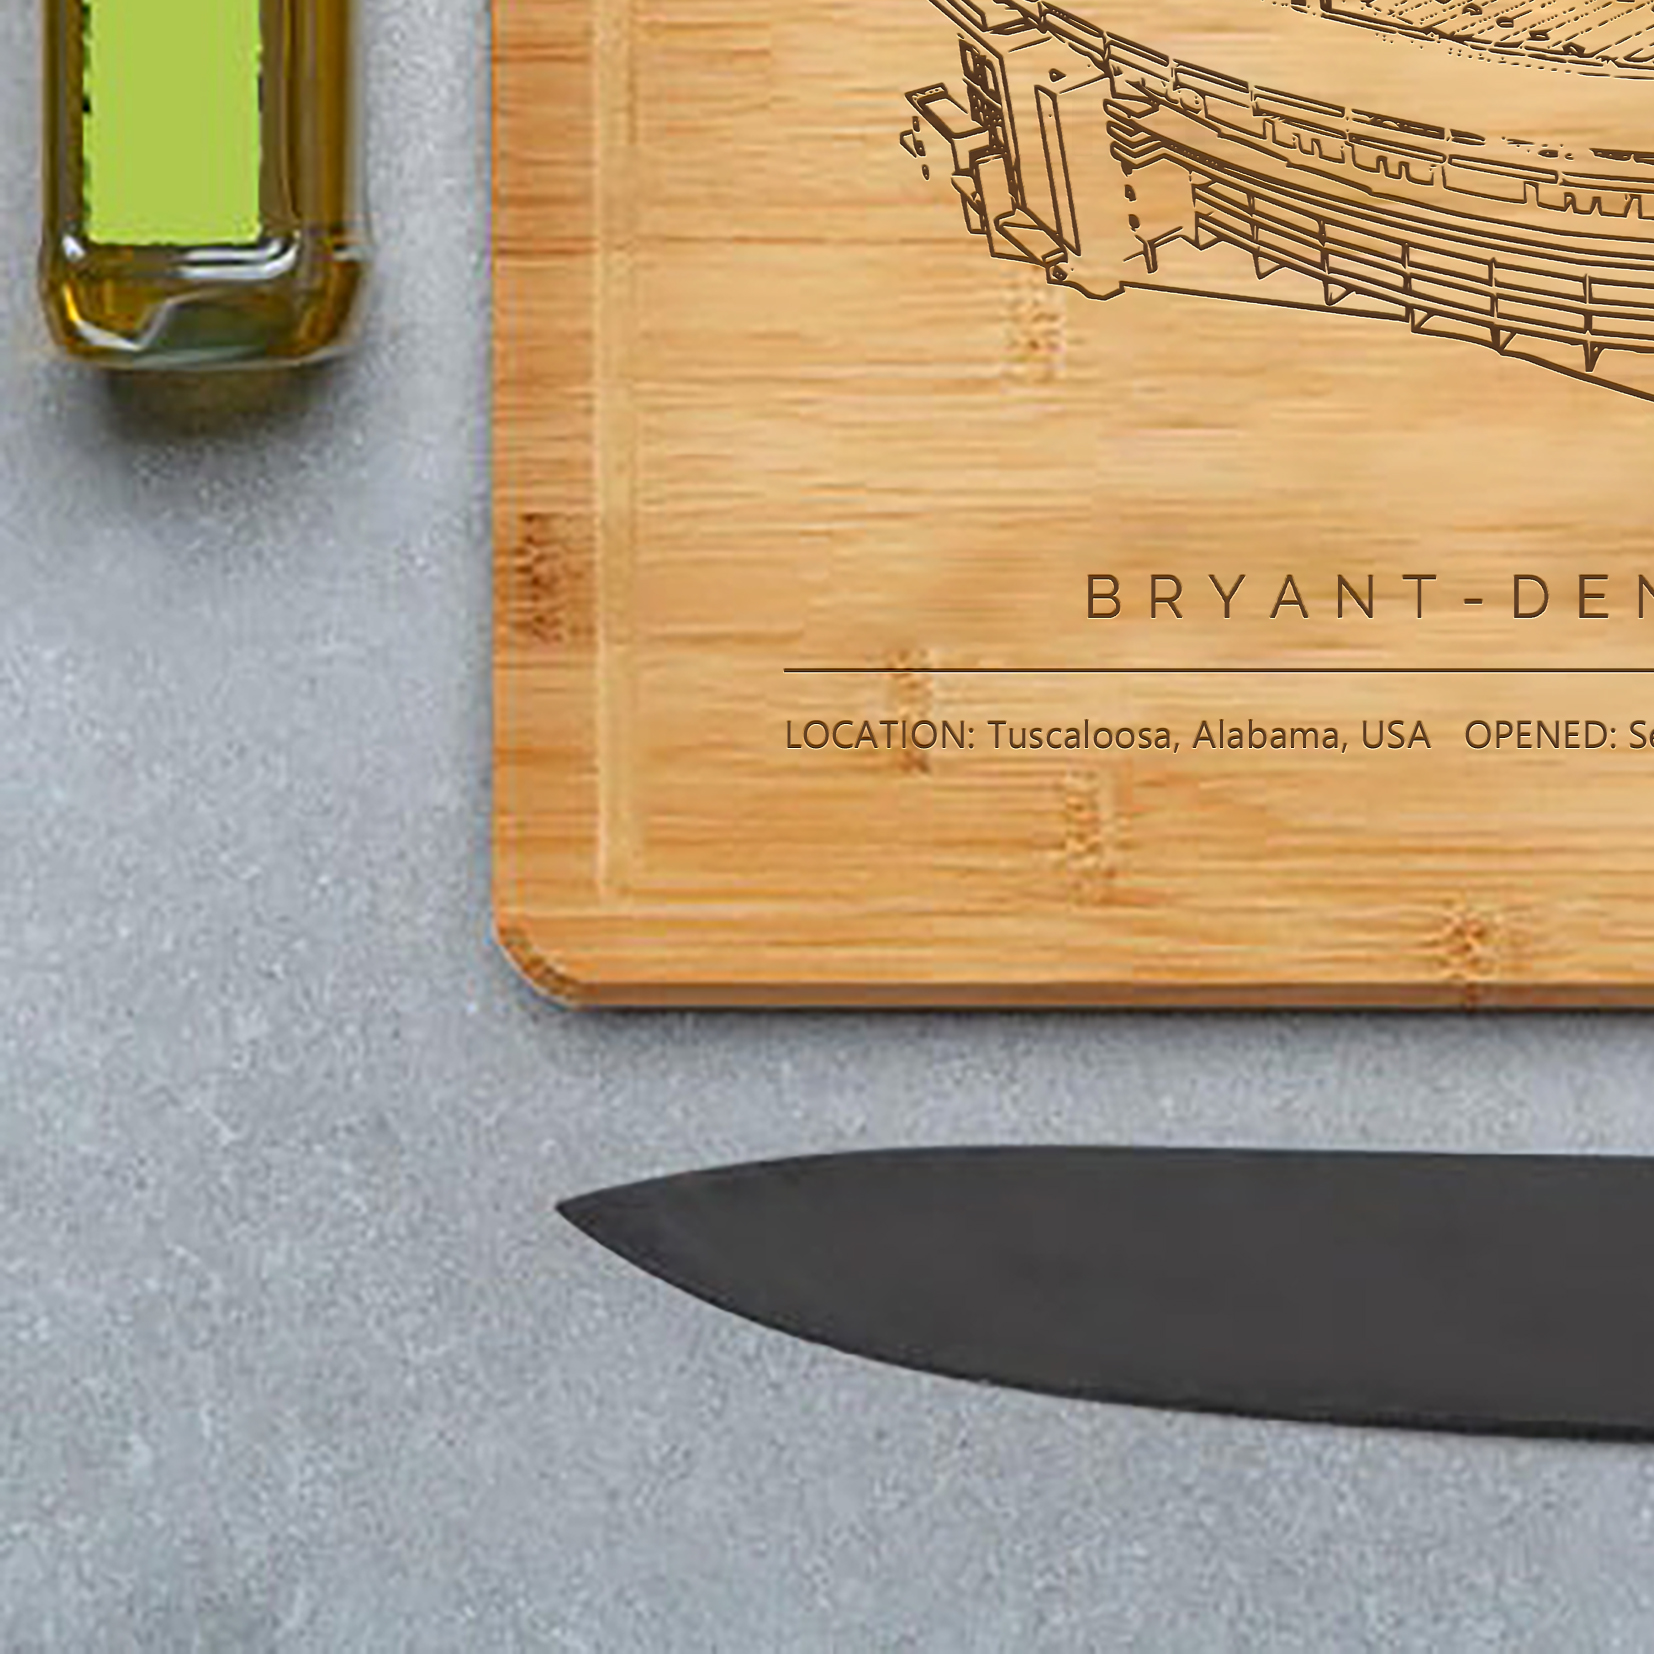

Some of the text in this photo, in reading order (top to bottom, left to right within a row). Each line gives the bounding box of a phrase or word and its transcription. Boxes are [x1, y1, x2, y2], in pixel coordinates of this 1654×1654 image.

[786, 719, 974, 749] LOCATION:
[987, 719, 1179, 754] Tuscaloosa,
[1192, 719, 1347, 754] Alabama,
[1363, 720, 1431, 749] USA
[1465, 720, 1616, 749] OPENED:
